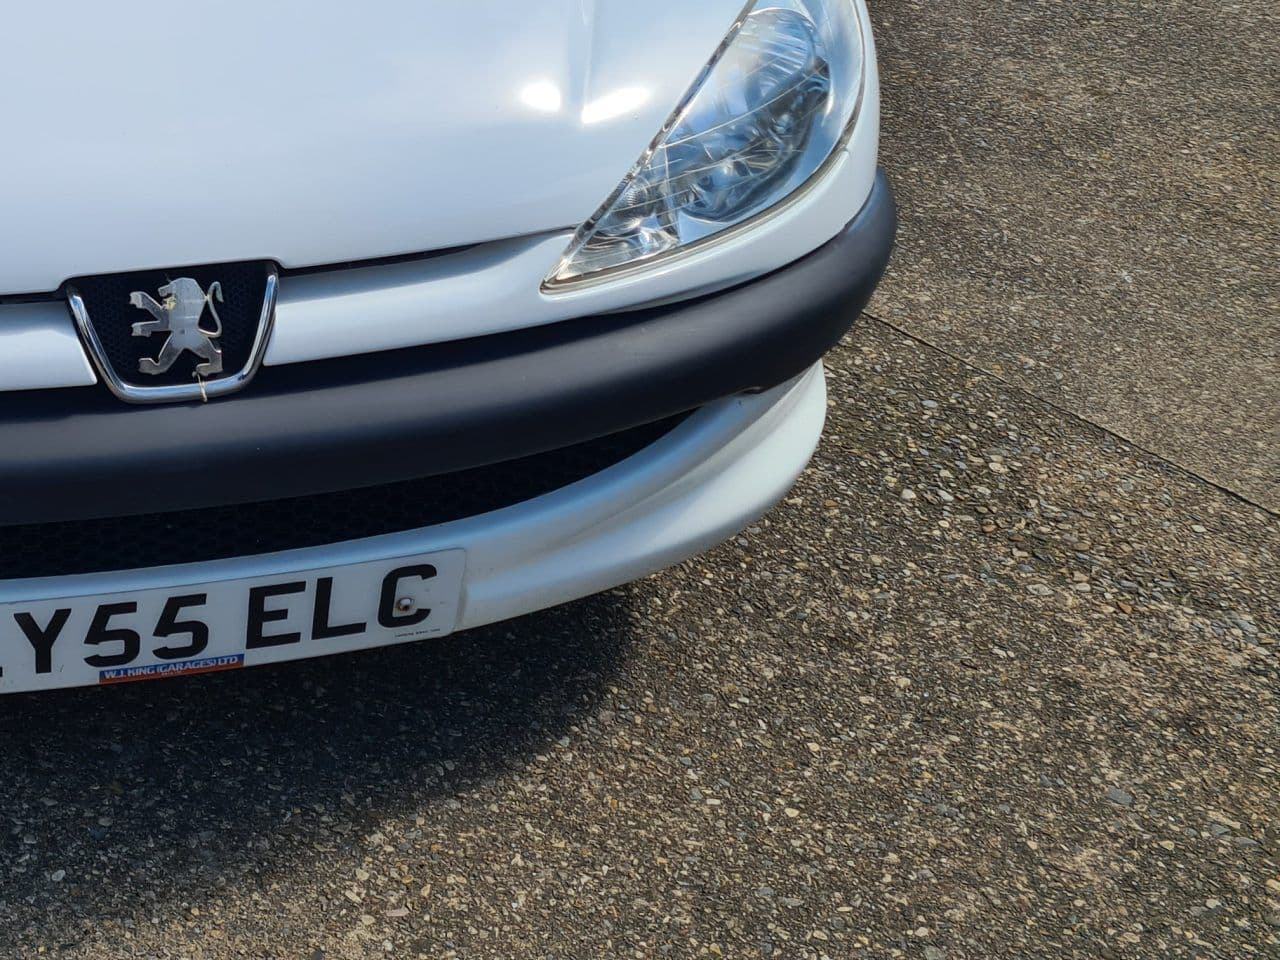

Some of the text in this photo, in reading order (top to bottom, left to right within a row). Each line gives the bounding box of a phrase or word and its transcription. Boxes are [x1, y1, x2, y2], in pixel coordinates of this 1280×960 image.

[246, 563, 438, 649] ELC
[128, 666, 155, 676] KING
[217, 655, 238, 665] LTD
